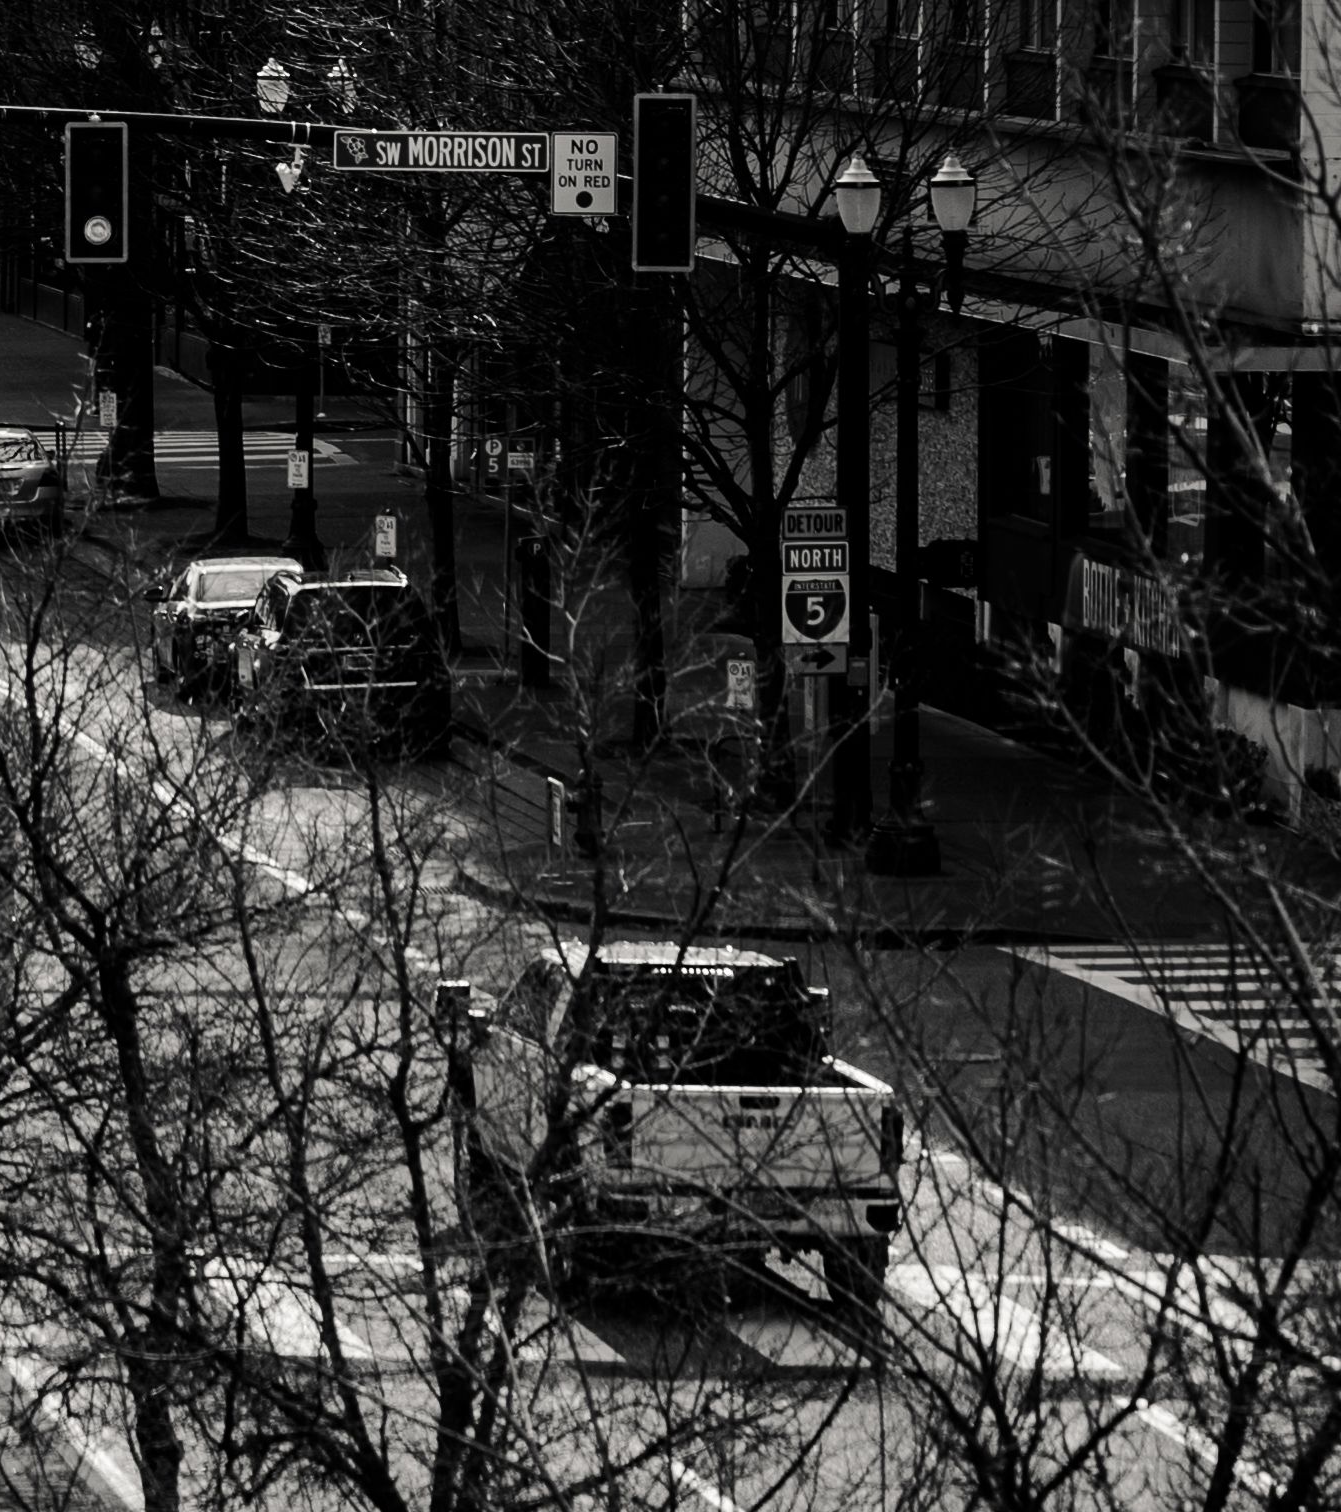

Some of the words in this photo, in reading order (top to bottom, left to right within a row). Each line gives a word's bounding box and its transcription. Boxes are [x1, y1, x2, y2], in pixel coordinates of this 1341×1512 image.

[376, 141, 401, 165] SW
[408, 137, 515, 166] MORRISON
[521, 143, 541, 167] ST
[571, 140, 598, 155] NO
[567, 159, 603, 171] TURN
[558, 176, 577, 187] ON
[584, 176, 611, 188] RED
[488, 457, 498, 473] 5
[787, 514, 843, 533] DETOUR
[790, 549, 842, 568] NORTH
[794, 581, 837, 592] INTERSTATE
[1083, 557, 1121, 640] BOTTLE
[807, 596, 825, 626] 5
